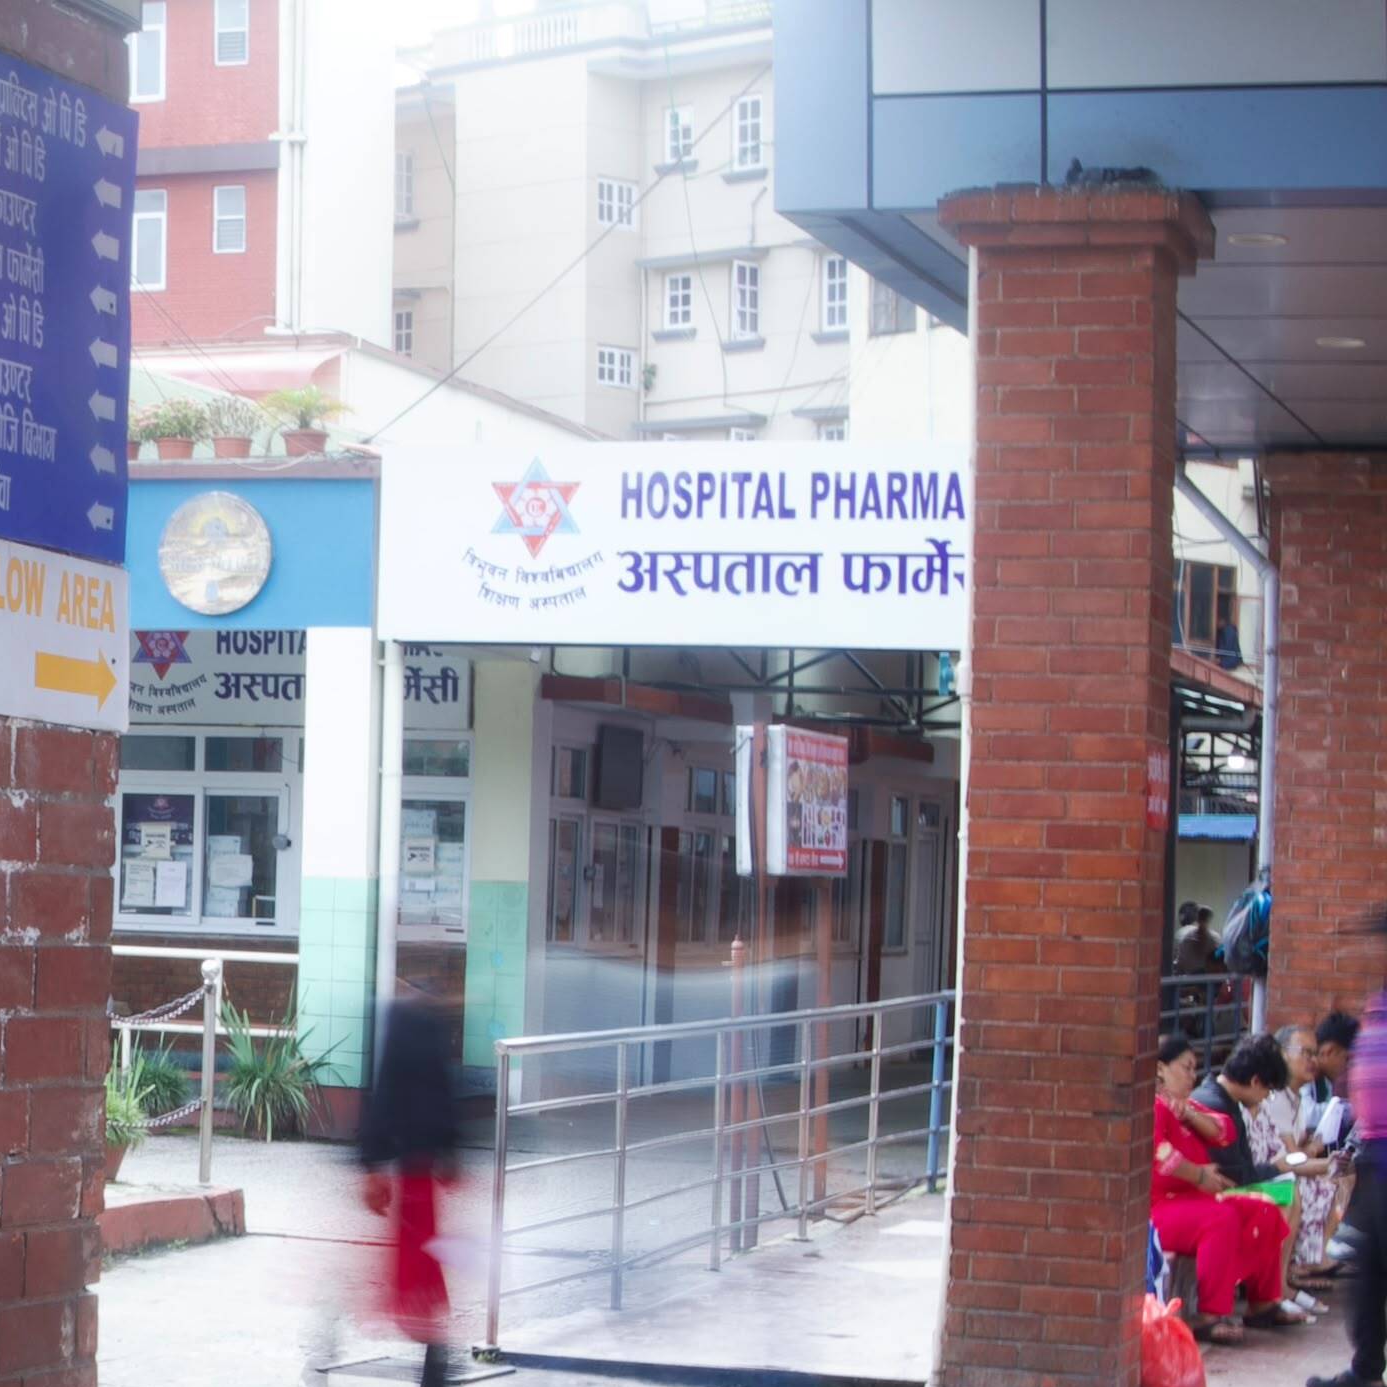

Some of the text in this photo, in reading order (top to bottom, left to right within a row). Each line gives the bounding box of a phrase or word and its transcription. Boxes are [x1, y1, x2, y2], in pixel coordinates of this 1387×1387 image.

[621, 471, 965, 519] HOSPITAL PHARMA
[617, 550, 823, 596] अस्पताल
[57, 570, 115, 633] AREA
[214, 672, 306, 701] अस्पत
